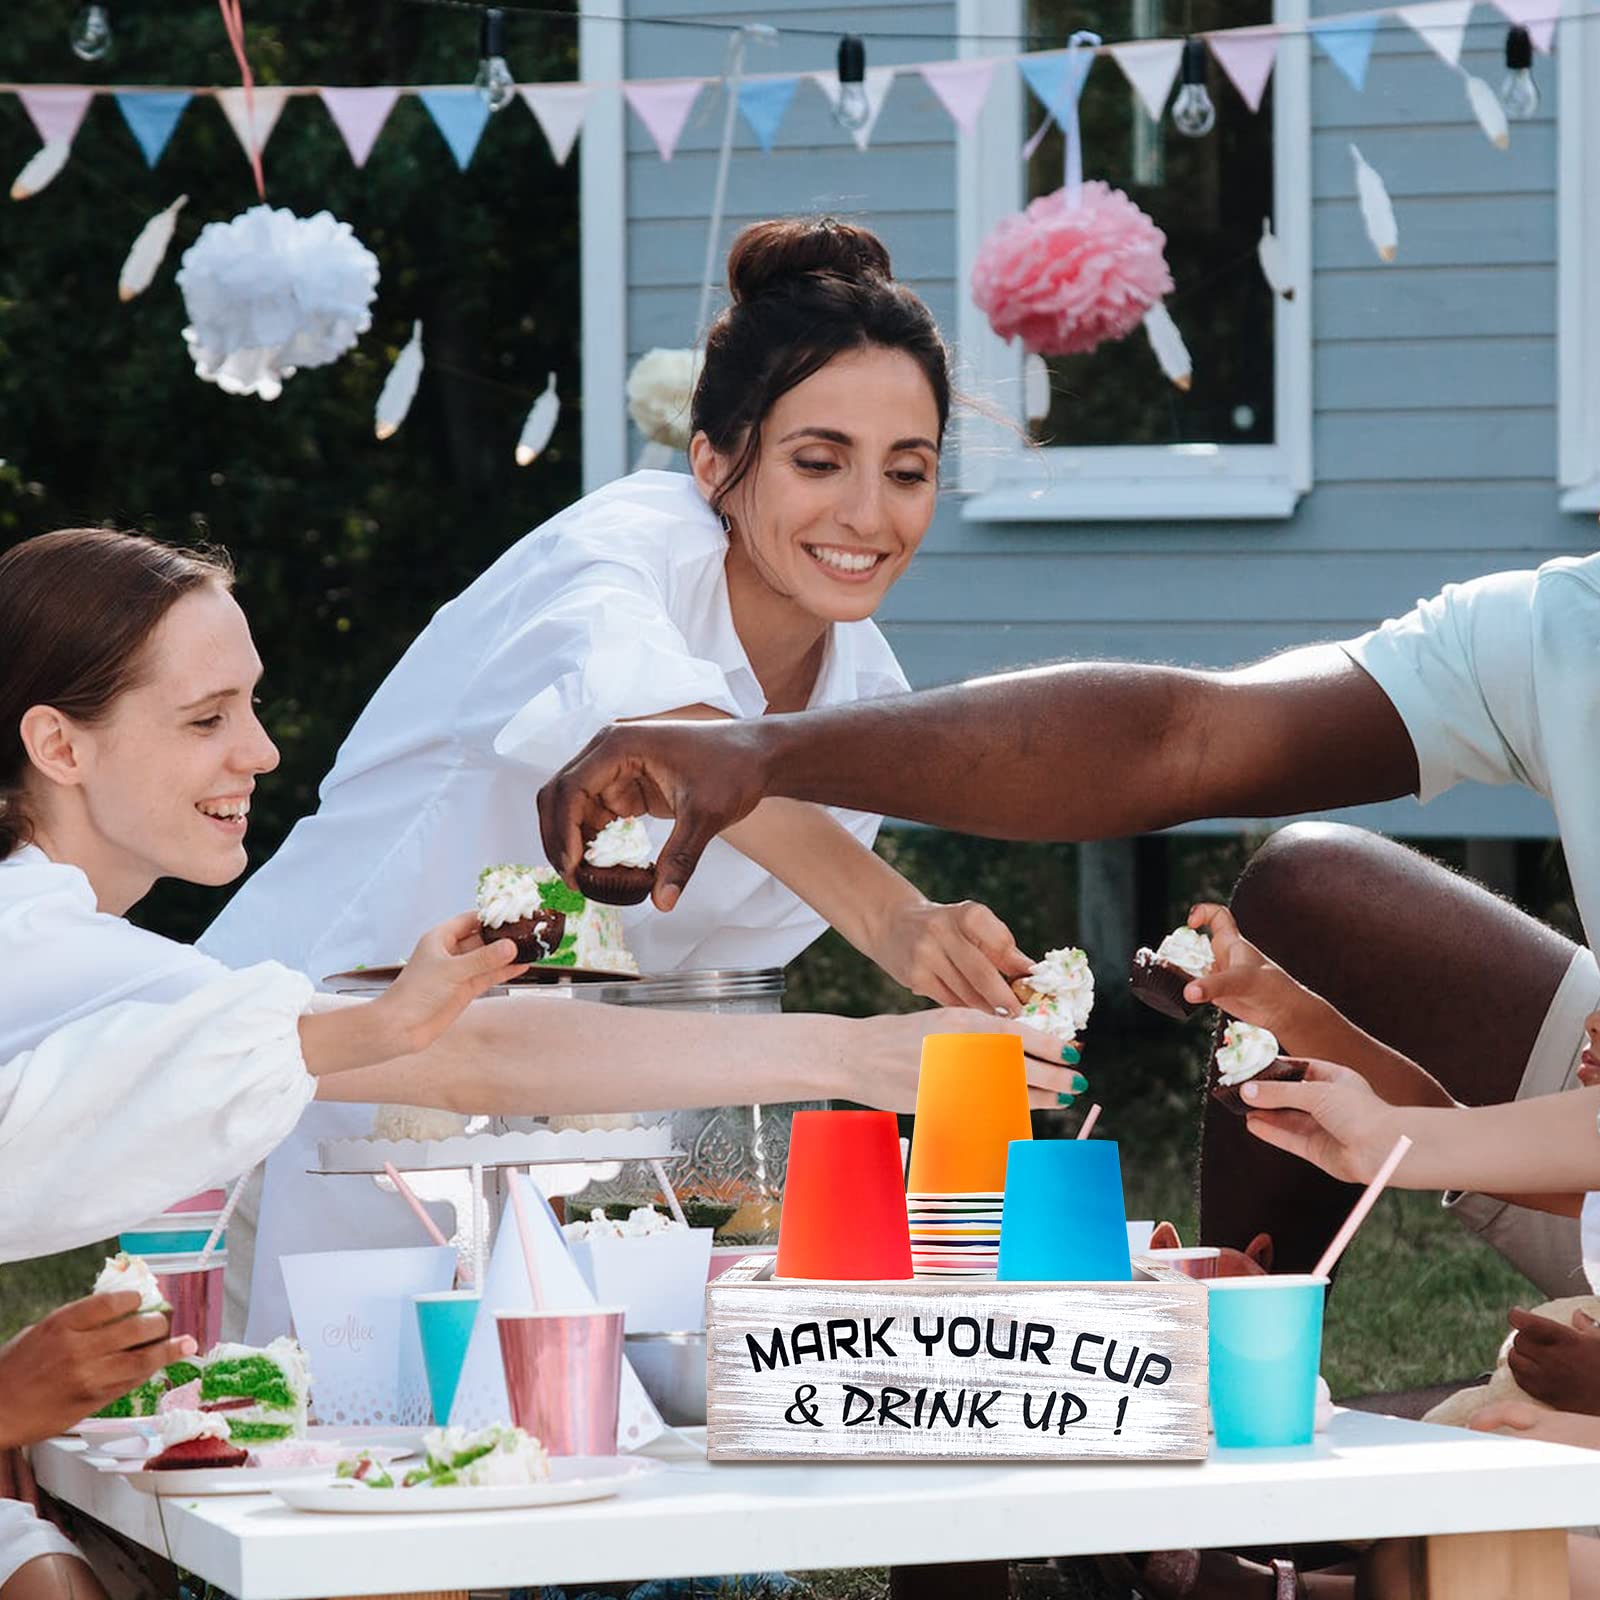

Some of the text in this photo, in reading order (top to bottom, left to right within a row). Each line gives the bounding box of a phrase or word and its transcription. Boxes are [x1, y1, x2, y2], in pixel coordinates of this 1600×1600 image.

[745, 1316, 1173, 1389] MARK YOUR CUP
[784, 1384, 1130, 1436] & DRINK UP !
